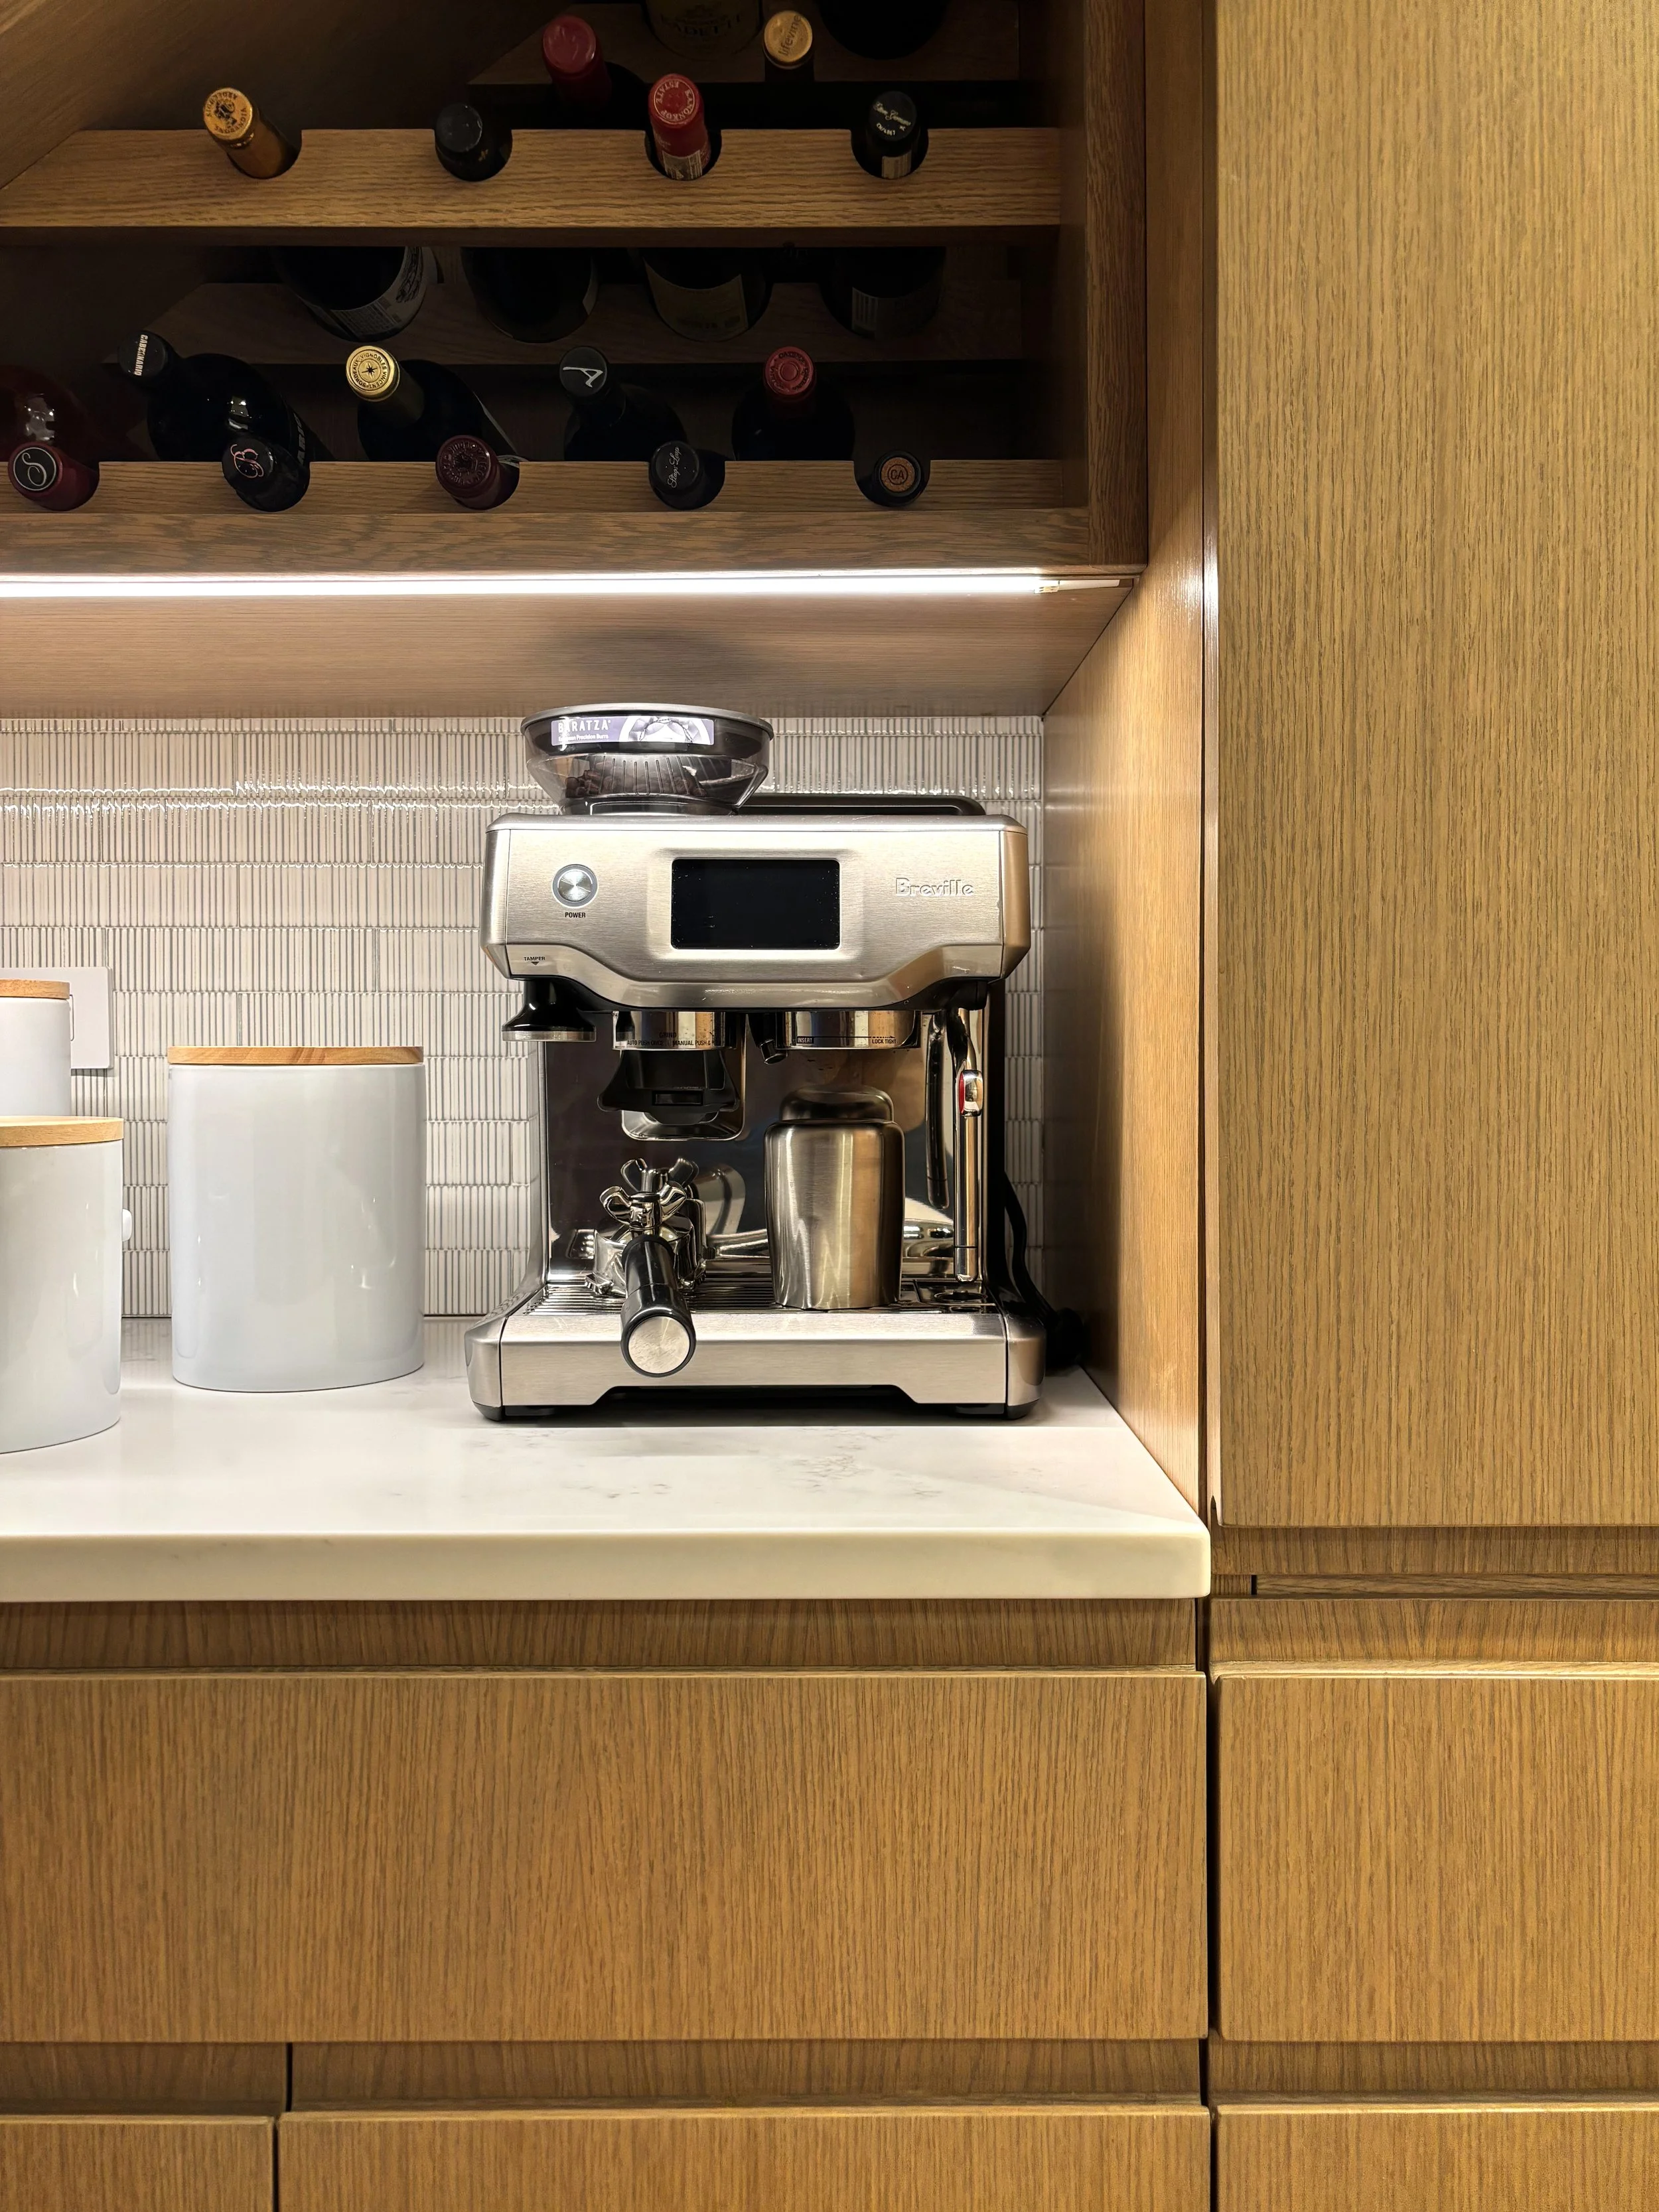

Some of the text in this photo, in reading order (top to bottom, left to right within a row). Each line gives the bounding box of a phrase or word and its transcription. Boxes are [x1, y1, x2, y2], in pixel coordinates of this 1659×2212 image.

[656, 82, 680, 104] ESTATE
[660, 89, 693, 121] KANONKOP
[352, 352, 387, 389] VIGNOBLES VINCENT BORDEAUX
[895, 877, 974, 897] Breville
